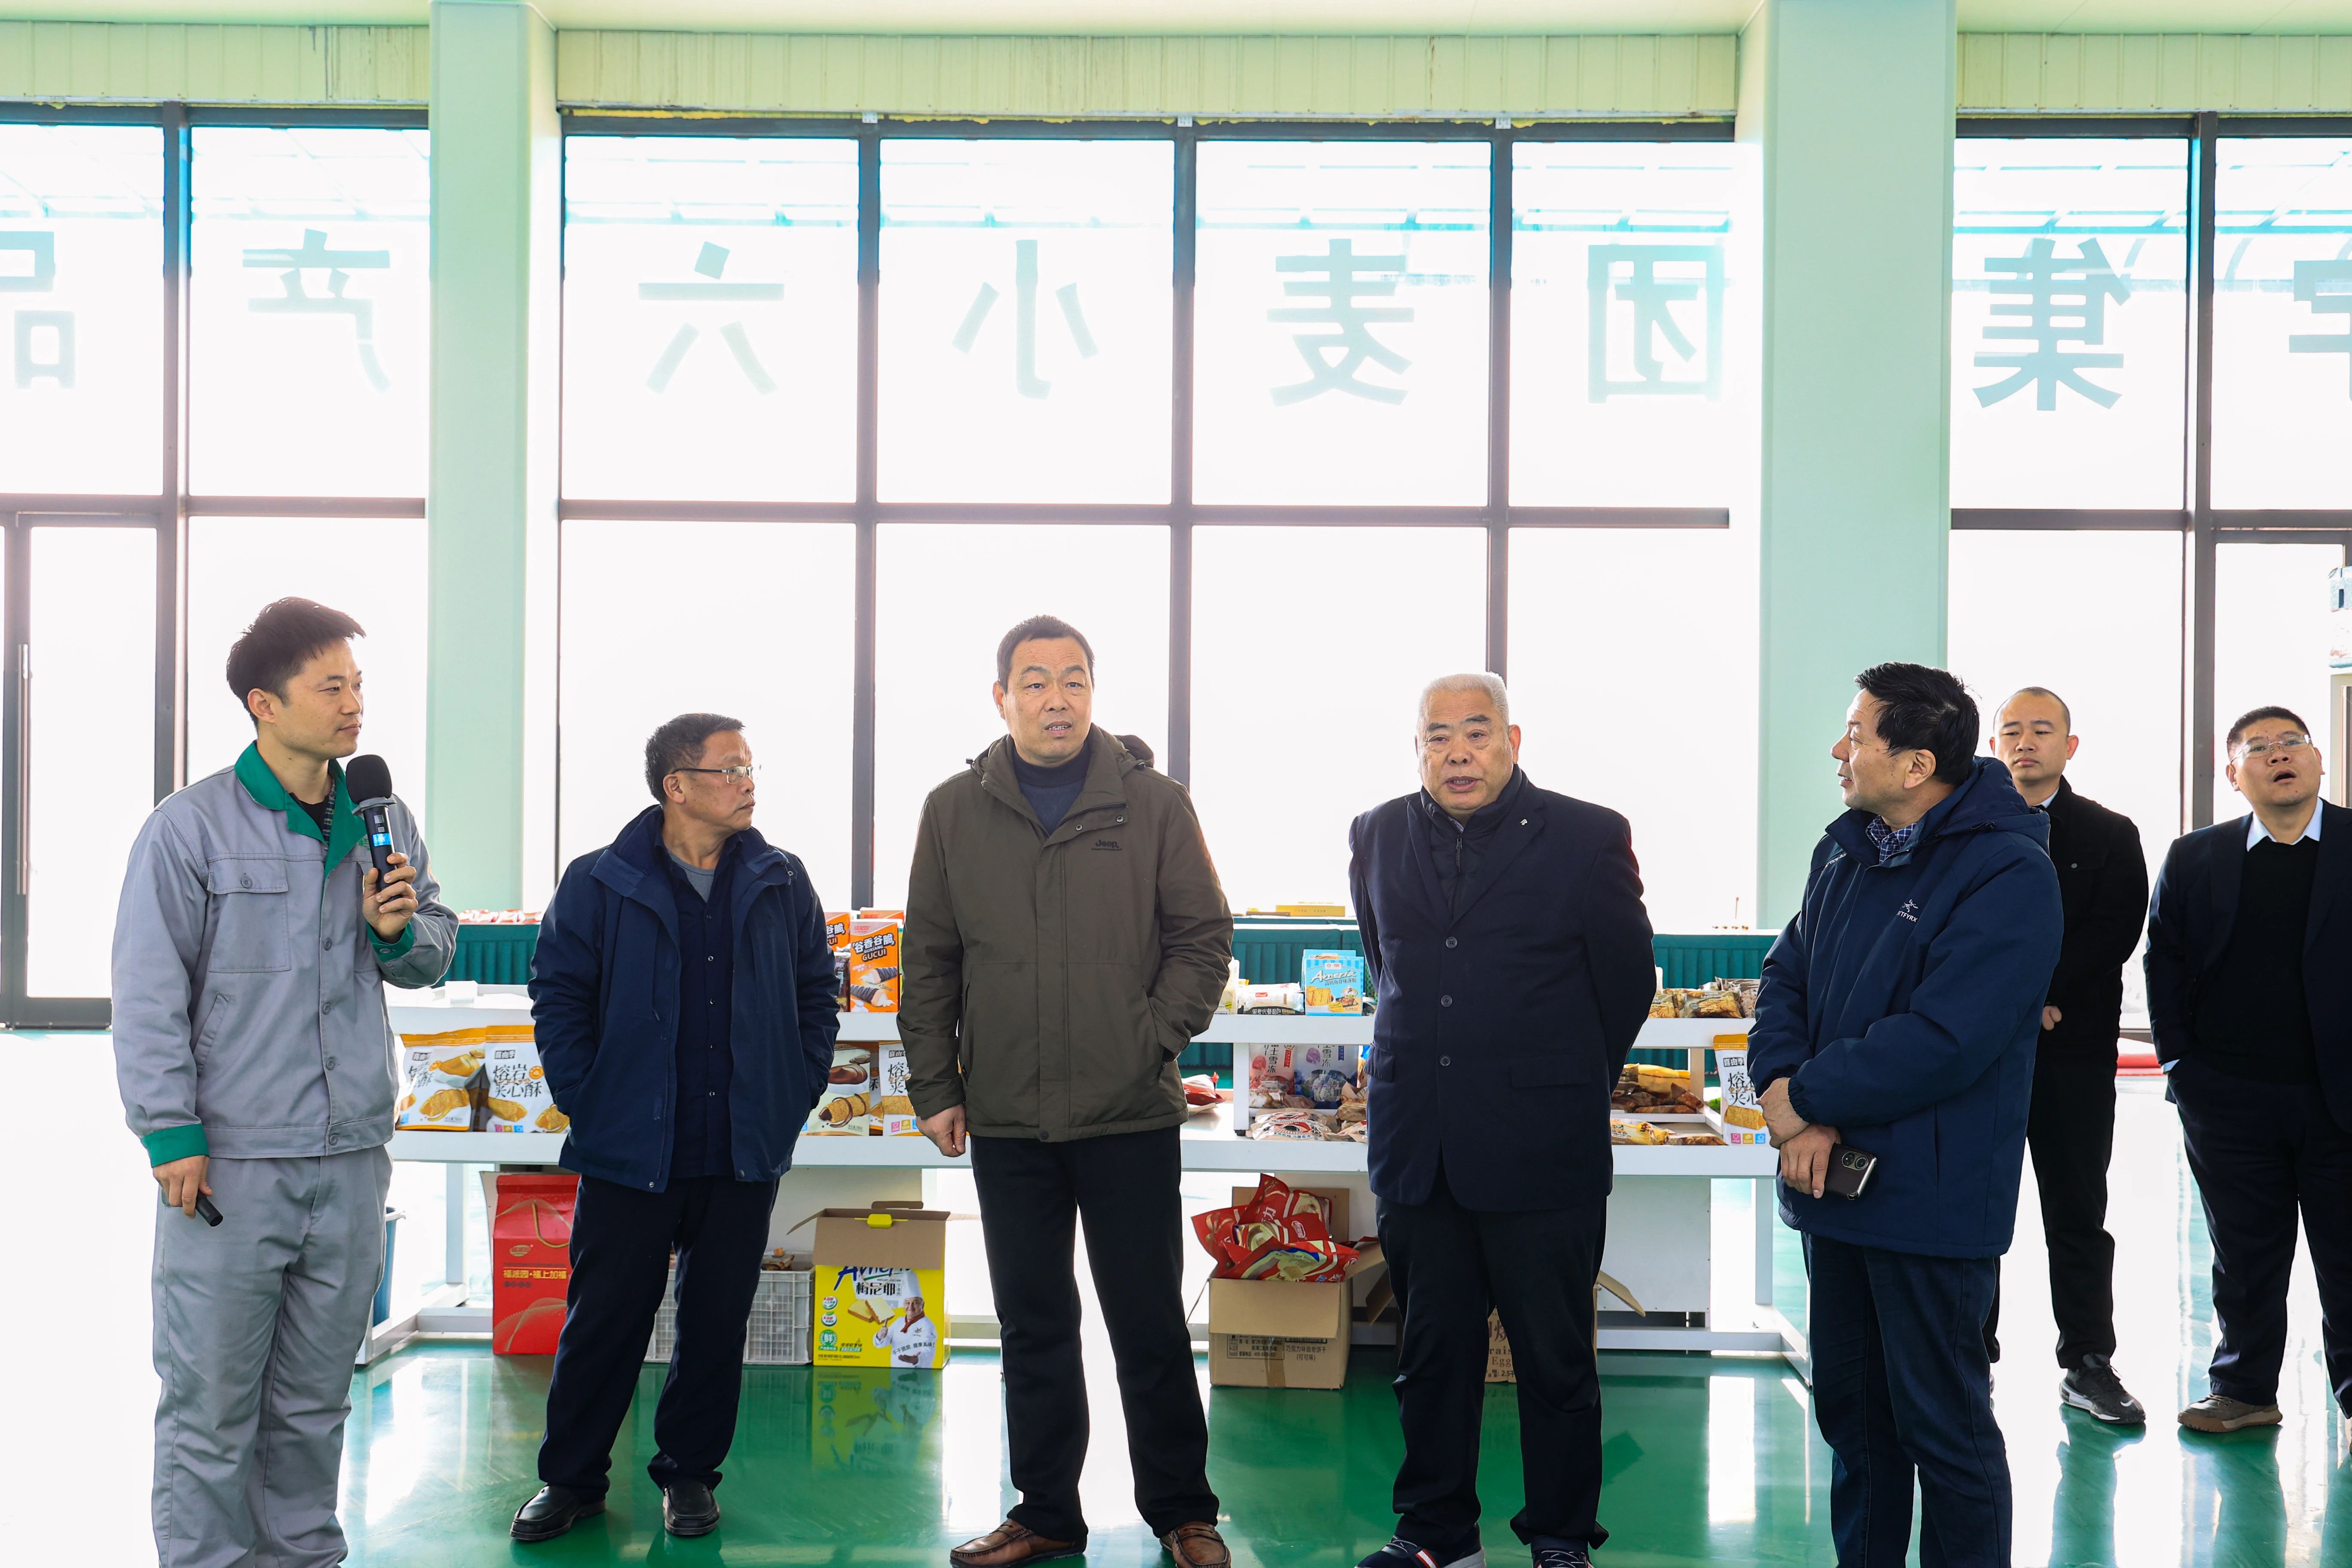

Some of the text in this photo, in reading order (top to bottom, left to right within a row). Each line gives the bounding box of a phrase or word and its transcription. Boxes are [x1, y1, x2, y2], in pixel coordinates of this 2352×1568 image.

[1095, 839, 1118, 848] Jeep
[853, 933, 895, 953] 谷香谷脆
[864, 945, 883, 953] GUXIANG
[862, 949, 886, 961] GUCUI
[1311, 970, 1357, 983] Ameria
[1723, 1057, 1744, 1067] 喜由季
[495, 1081, 542, 1097] 夹心酥
